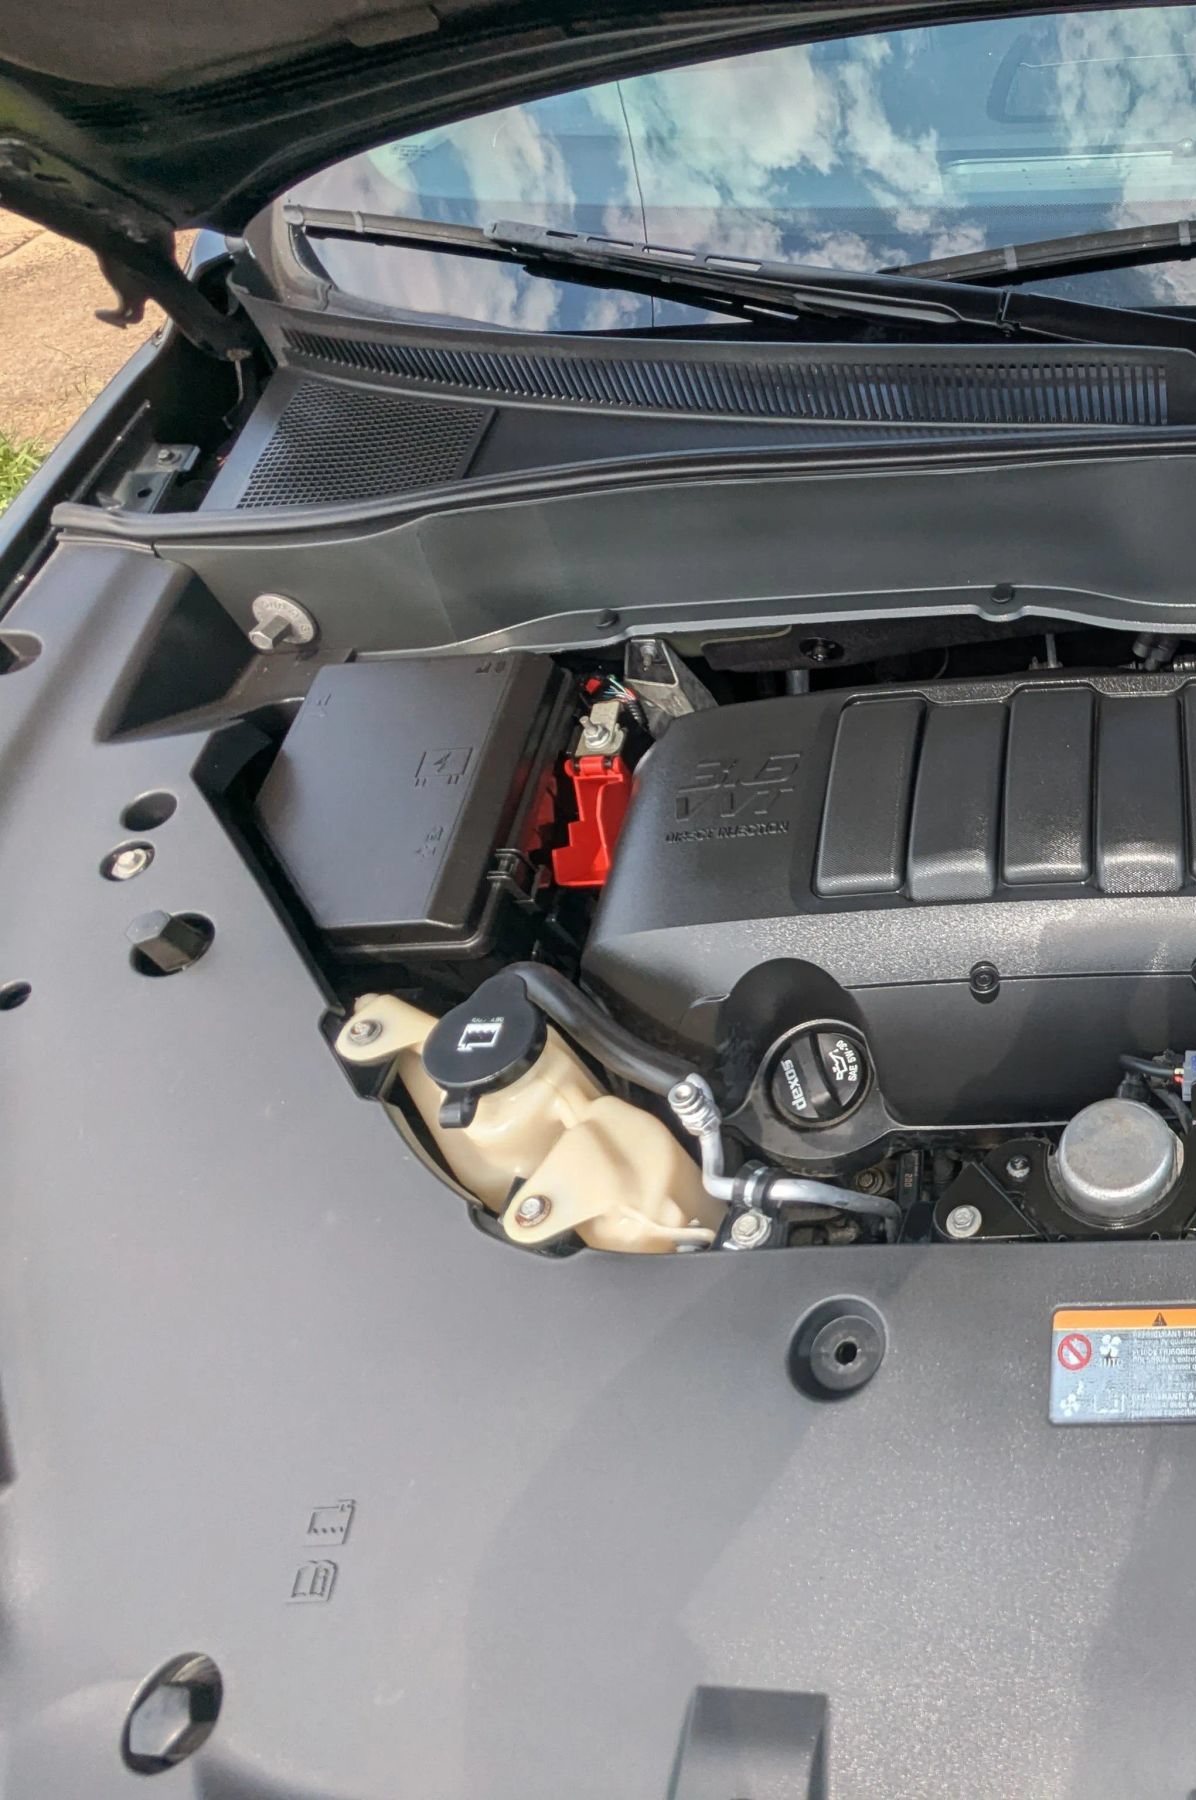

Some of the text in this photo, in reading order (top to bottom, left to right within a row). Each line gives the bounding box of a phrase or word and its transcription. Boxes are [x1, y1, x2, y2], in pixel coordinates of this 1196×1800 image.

[676, 788, 794, 823] VVT
[666, 821, 790, 843] DIRECT INJECTION
[780, 1059, 808, 1111] dexos
[847, 1064, 858, 1082] SAE
